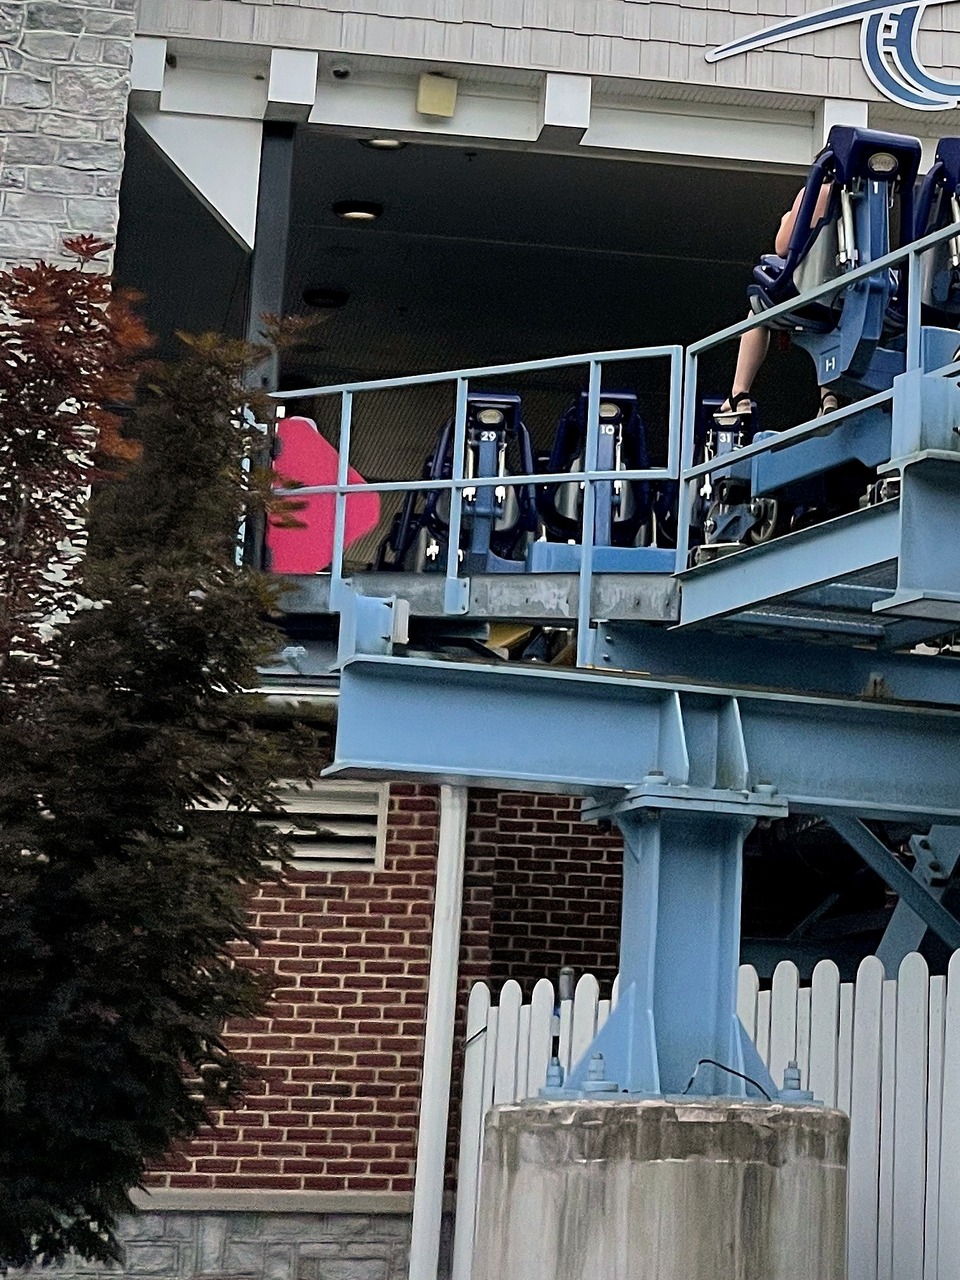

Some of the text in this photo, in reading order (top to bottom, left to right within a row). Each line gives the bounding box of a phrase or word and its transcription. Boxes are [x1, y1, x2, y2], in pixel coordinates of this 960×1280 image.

[873, 181, 879, 194] 1
[480, 431, 497, 442] 29
[719, 432, 731, 443] 31
